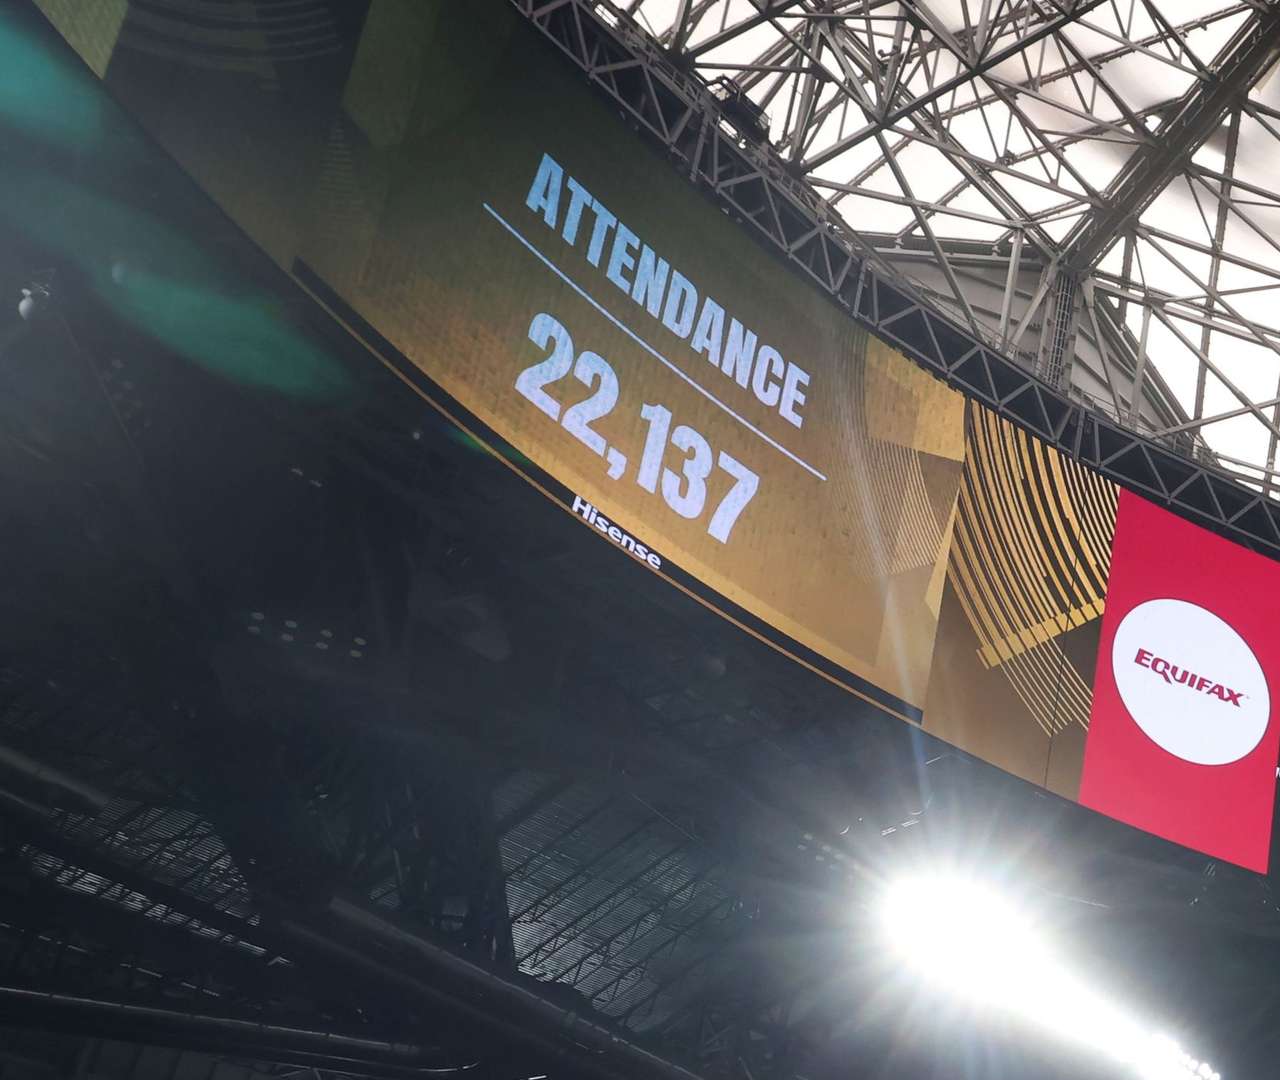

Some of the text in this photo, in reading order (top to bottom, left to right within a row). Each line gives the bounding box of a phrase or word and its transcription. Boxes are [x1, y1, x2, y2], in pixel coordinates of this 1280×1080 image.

[525, 152, 810, 428] ATTENDANCE
[514, 312, 760, 546] 22,137
[572, 494, 662, 570] Hisense
[1134, 647, 1243, 709] EQUIFAX
